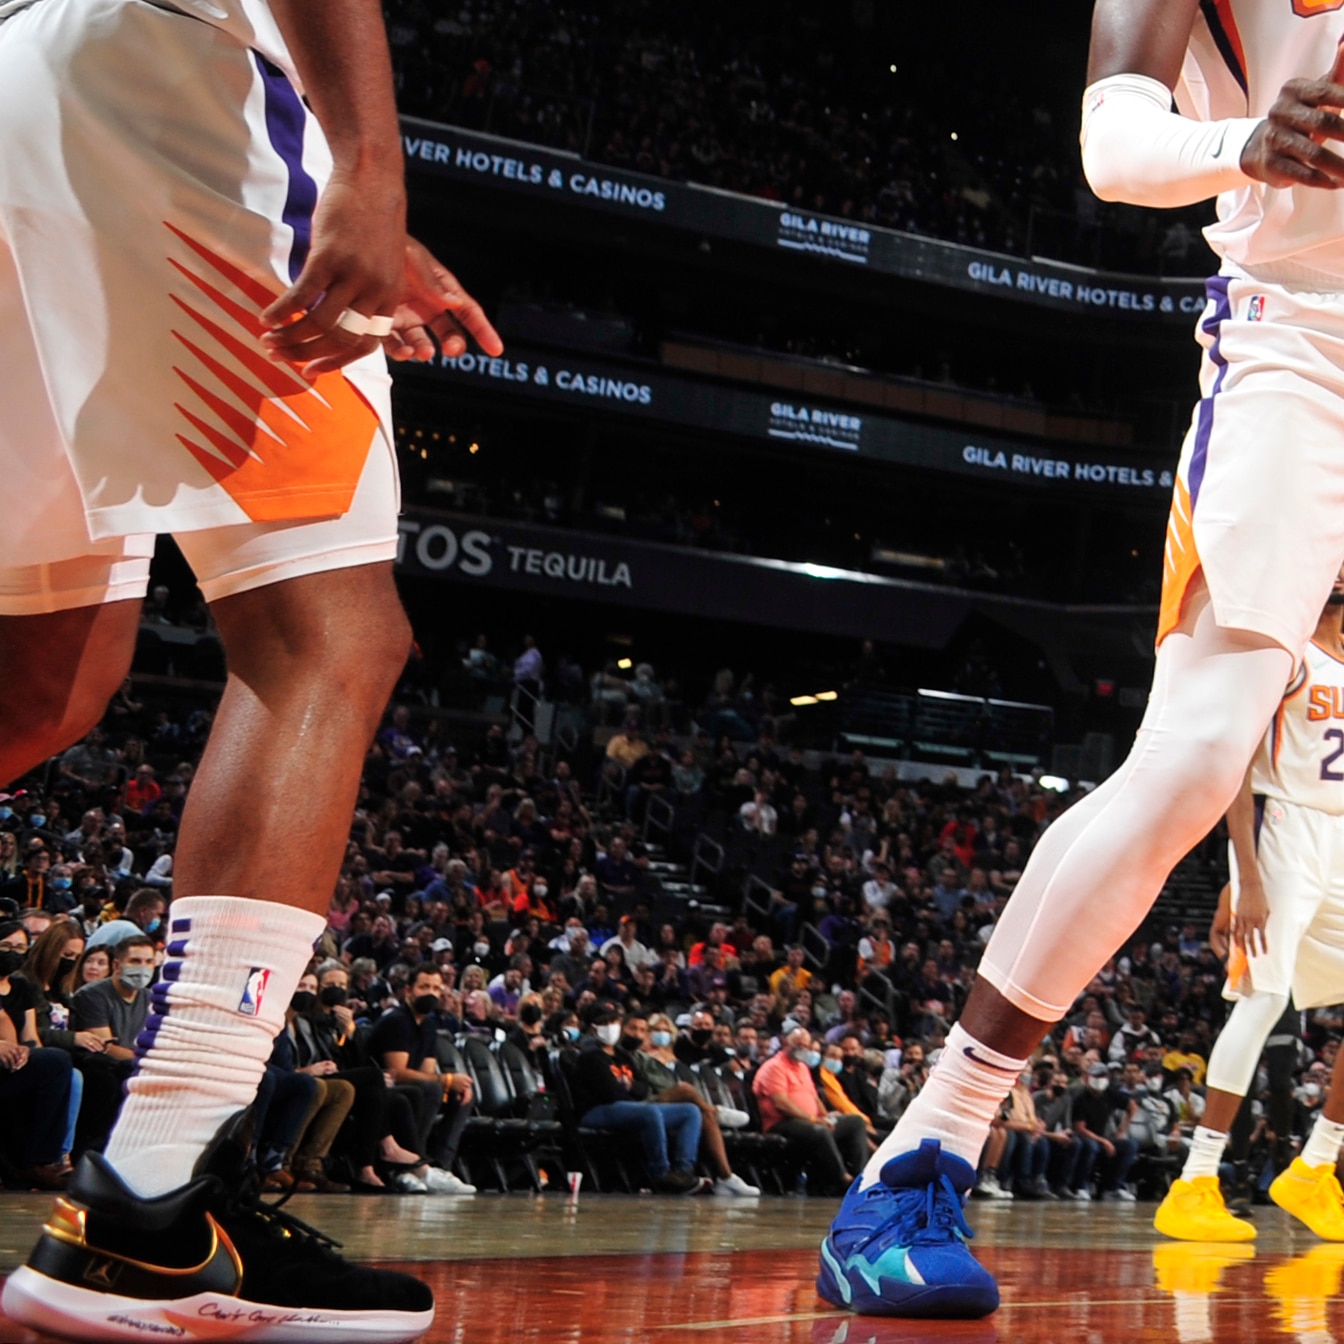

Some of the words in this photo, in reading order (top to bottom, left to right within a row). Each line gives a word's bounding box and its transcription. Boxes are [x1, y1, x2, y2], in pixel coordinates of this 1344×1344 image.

[455, 147, 543, 185] HOTELS
[548, 168, 563, 189] &
[569, 174, 667, 211] CASINOS
[779, 212, 819, 233] GILA
[820, 221, 872, 244] RIVER
[968, 261, 1013, 288] GILA
[1017, 272, 1073, 301] RIVER
[1076, 286, 1154, 312] HOTELS
[1159, 296, 1173, 313] &
[440, 352, 529, 382] HOTELS
[533, 366, 549, 386] &
[556, 370, 652, 404] CASINOS
[770, 402, 809, 423] GILA
[811, 408, 863, 431] RIVER
[963, 445, 1008, 470] GILA
[1011, 455, 1071, 479] RIVER
[1074, 463, 1155, 487] HOTELS
[507, 545, 632, 587] TEQUILA
